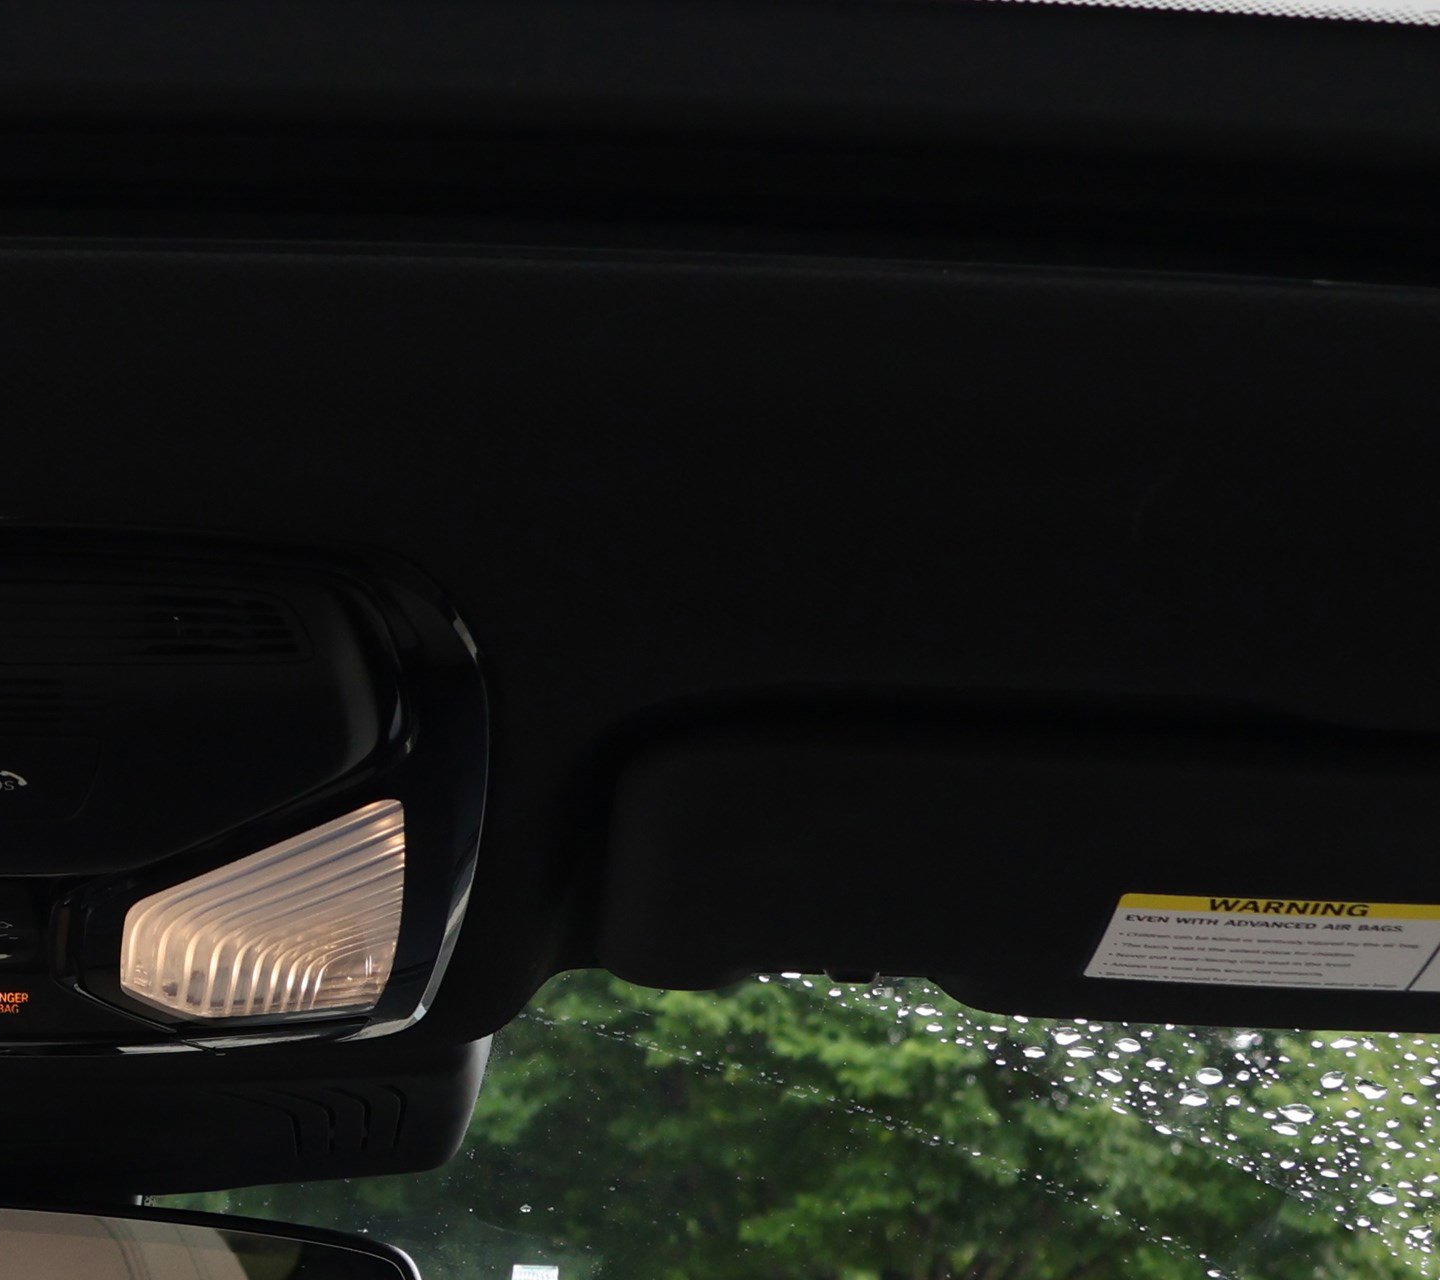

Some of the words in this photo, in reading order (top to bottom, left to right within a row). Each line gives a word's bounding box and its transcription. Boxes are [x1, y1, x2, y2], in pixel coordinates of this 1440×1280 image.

[1210, 899, 1369, 916] WARNING
[1126, 914, 1169, 923] EVEN
[1176, 917, 1218, 925] WITH
[1225, 920, 1316, 928] ADVANCED
